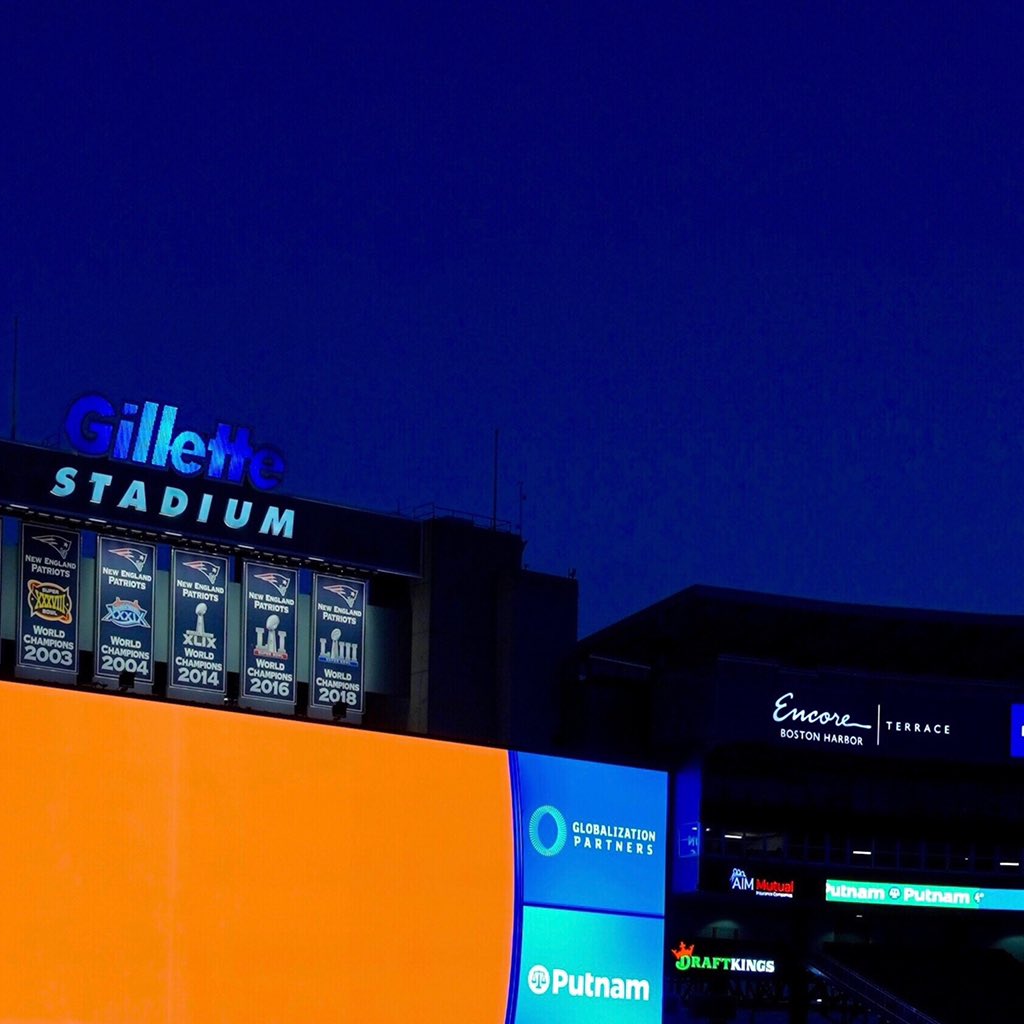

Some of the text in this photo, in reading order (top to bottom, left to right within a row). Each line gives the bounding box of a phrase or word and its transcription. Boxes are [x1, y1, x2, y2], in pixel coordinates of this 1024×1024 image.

[64, 393, 286, 491] Gillette
[49, 466, 296, 539] STADIUM
[25, 554, 76, 570] NEW ENGLAND
[31, 564, 71, 578] PATRIOTS
[102, 567, 152, 582] NEW ENGLAND
[108, 576, 146, 590] PATRIOTS
[177, 580, 224, 594] NEW ENGLAND
[182, 588, 219, 602] PATRIOTS
[249, 592, 294, 606] NEW ENGLAND
[254, 600, 289, 614] PATRIOTS
[317, 603, 362, 617] NEW ENGLAND
[322, 612, 357, 625] PATRIOTS
[33, 625, 65, 639] WORLD
[23, 634, 74, 650] CHAMPIONS
[110, 636, 141, 649] WORLD
[183, 633, 217, 649] XLIX
[24, 645, 73, 666] 2003
[101, 645, 150, 660] CHAMPIONS
[184, 648, 214, 660] WORLD
[101, 655, 149, 675] 2004
[176, 656, 222, 672] CHAMPIONS
[256, 659, 285, 671] WORLD
[178, 667, 220, 686] 2014
[247, 667, 293, 681] CHAMPIONS
[324, 669, 352, 681] WORLD
[249, 677, 290, 697] 2016
[316, 677, 360, 692] CHAMPIONS
[318, 688, 357, 706] 2018
[772, 692, 872, 730] Encore
[886, 721, 951, 735] TERRACE
[780, 729, 864, 746] BOSTON HARBOR
[572, 821, 656, 842] GLOBALIZATION
[573, 836, 654, 855] PARTNERS
[732, 877, 794, 892] AIM Mutual
[904, 888, 970, 904] Putnam
[675, 955, 775, 973] DRAFTKINGS
[552, 968, 649, 1001] Putnam
